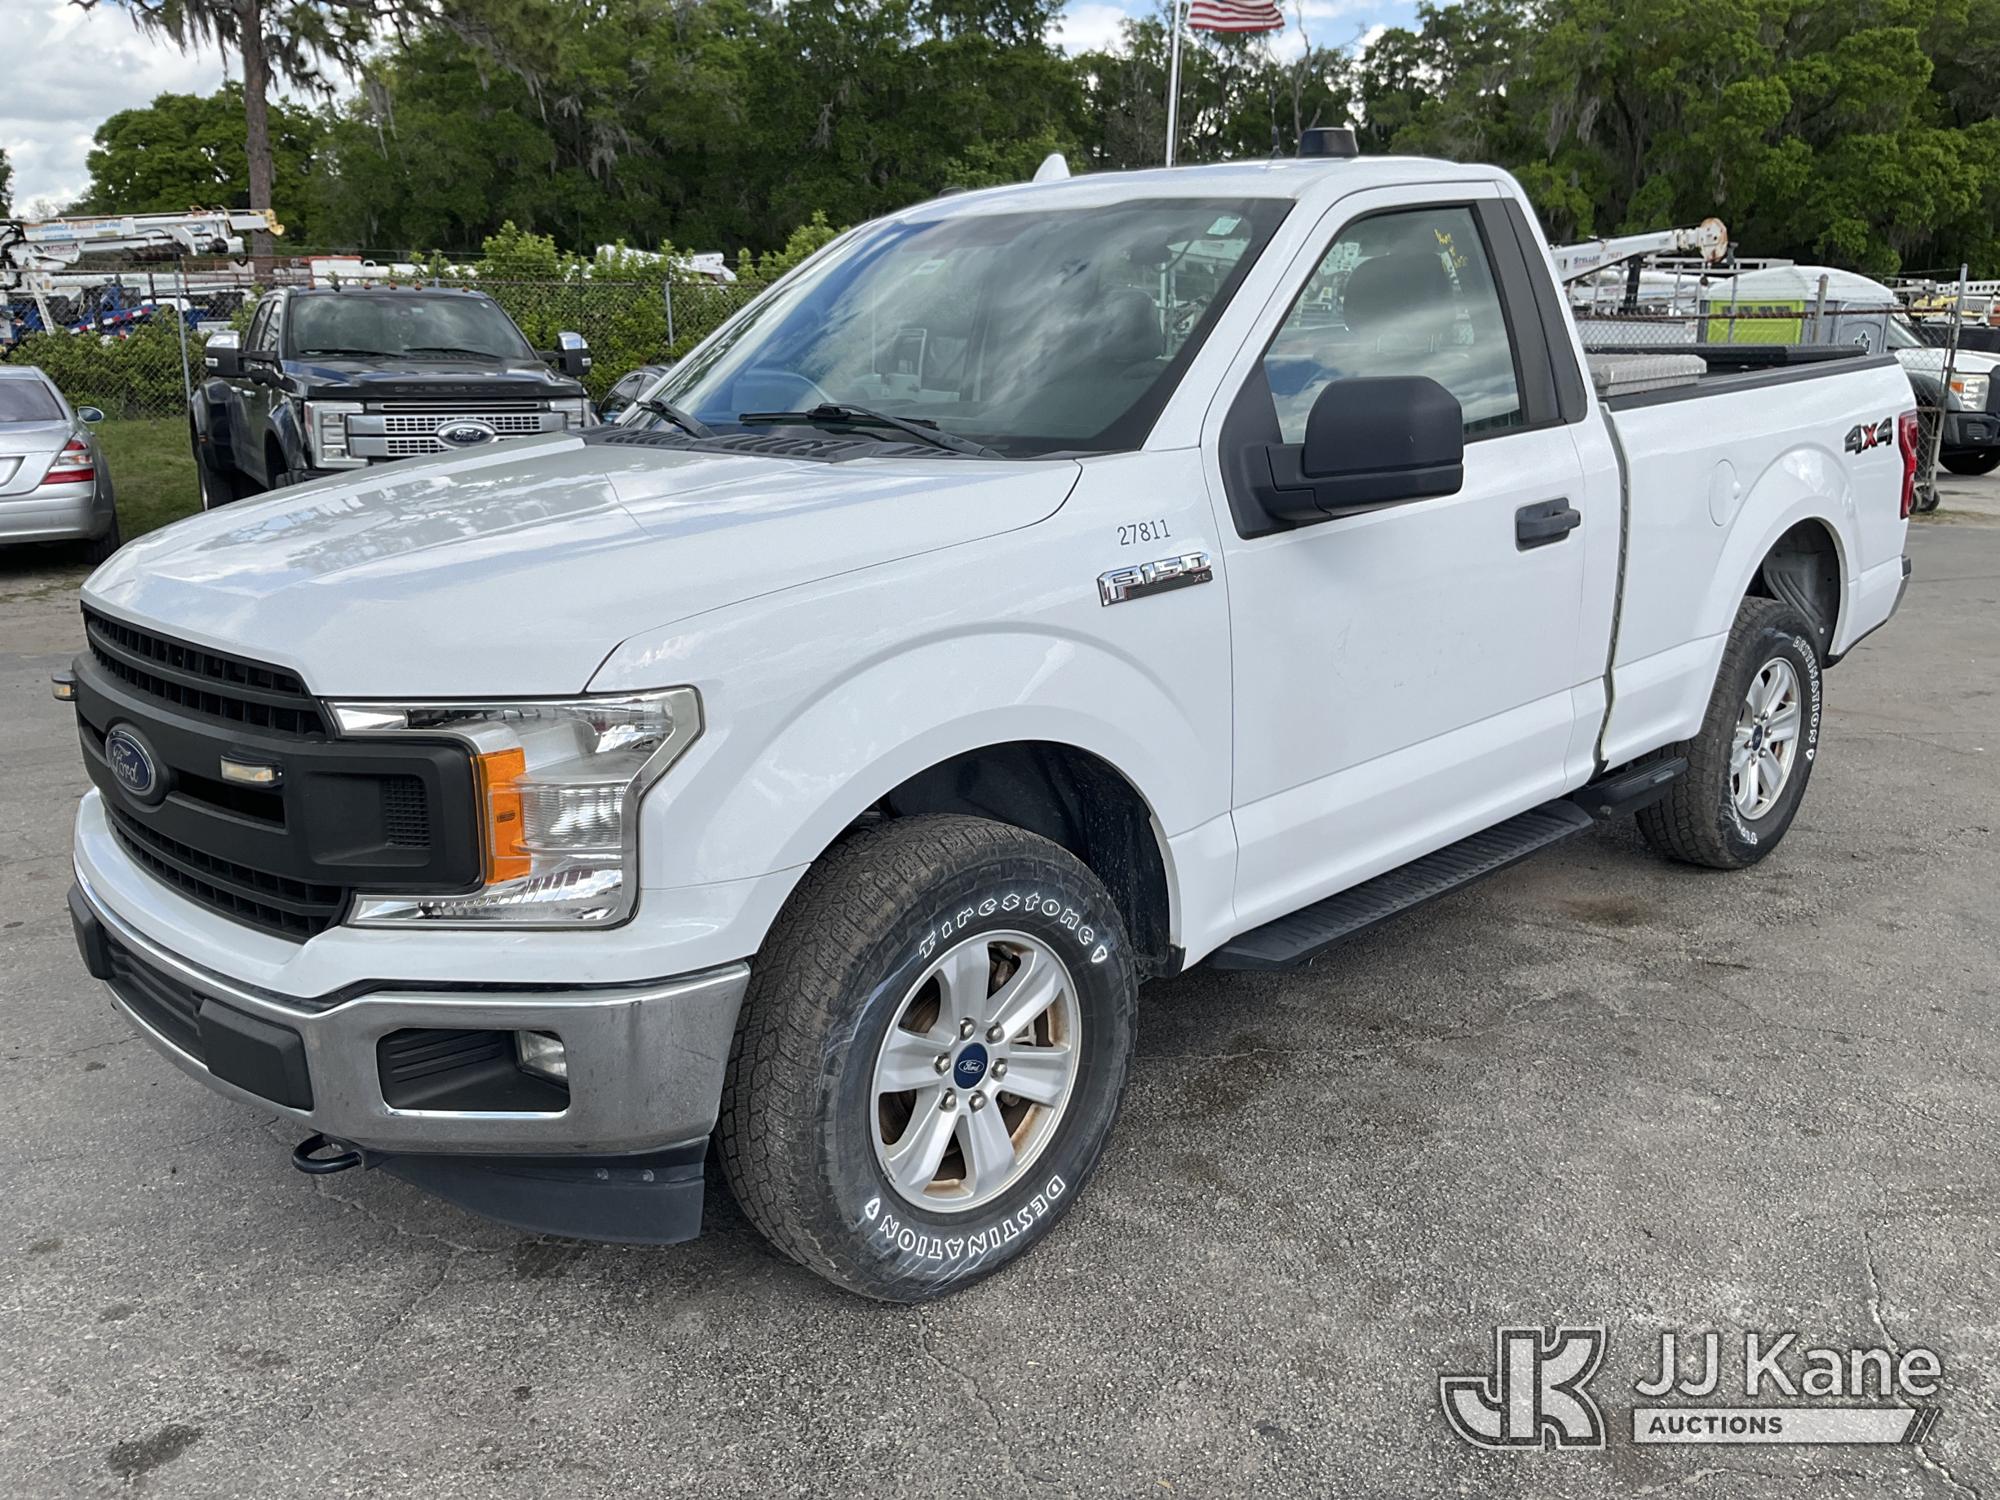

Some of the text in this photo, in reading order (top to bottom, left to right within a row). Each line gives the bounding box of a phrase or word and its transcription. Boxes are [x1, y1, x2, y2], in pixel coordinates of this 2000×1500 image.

[454, 429, 481, 441] Ford
[1117, 519, 1171, 545] 27811
[1793, 635, 1820, 744] DESTINATION
[111, 744, 138, 782] Ford
[918, 892, 1094, 960] Firestone
[879, 1174, 1066, 1260] DESTINATION
